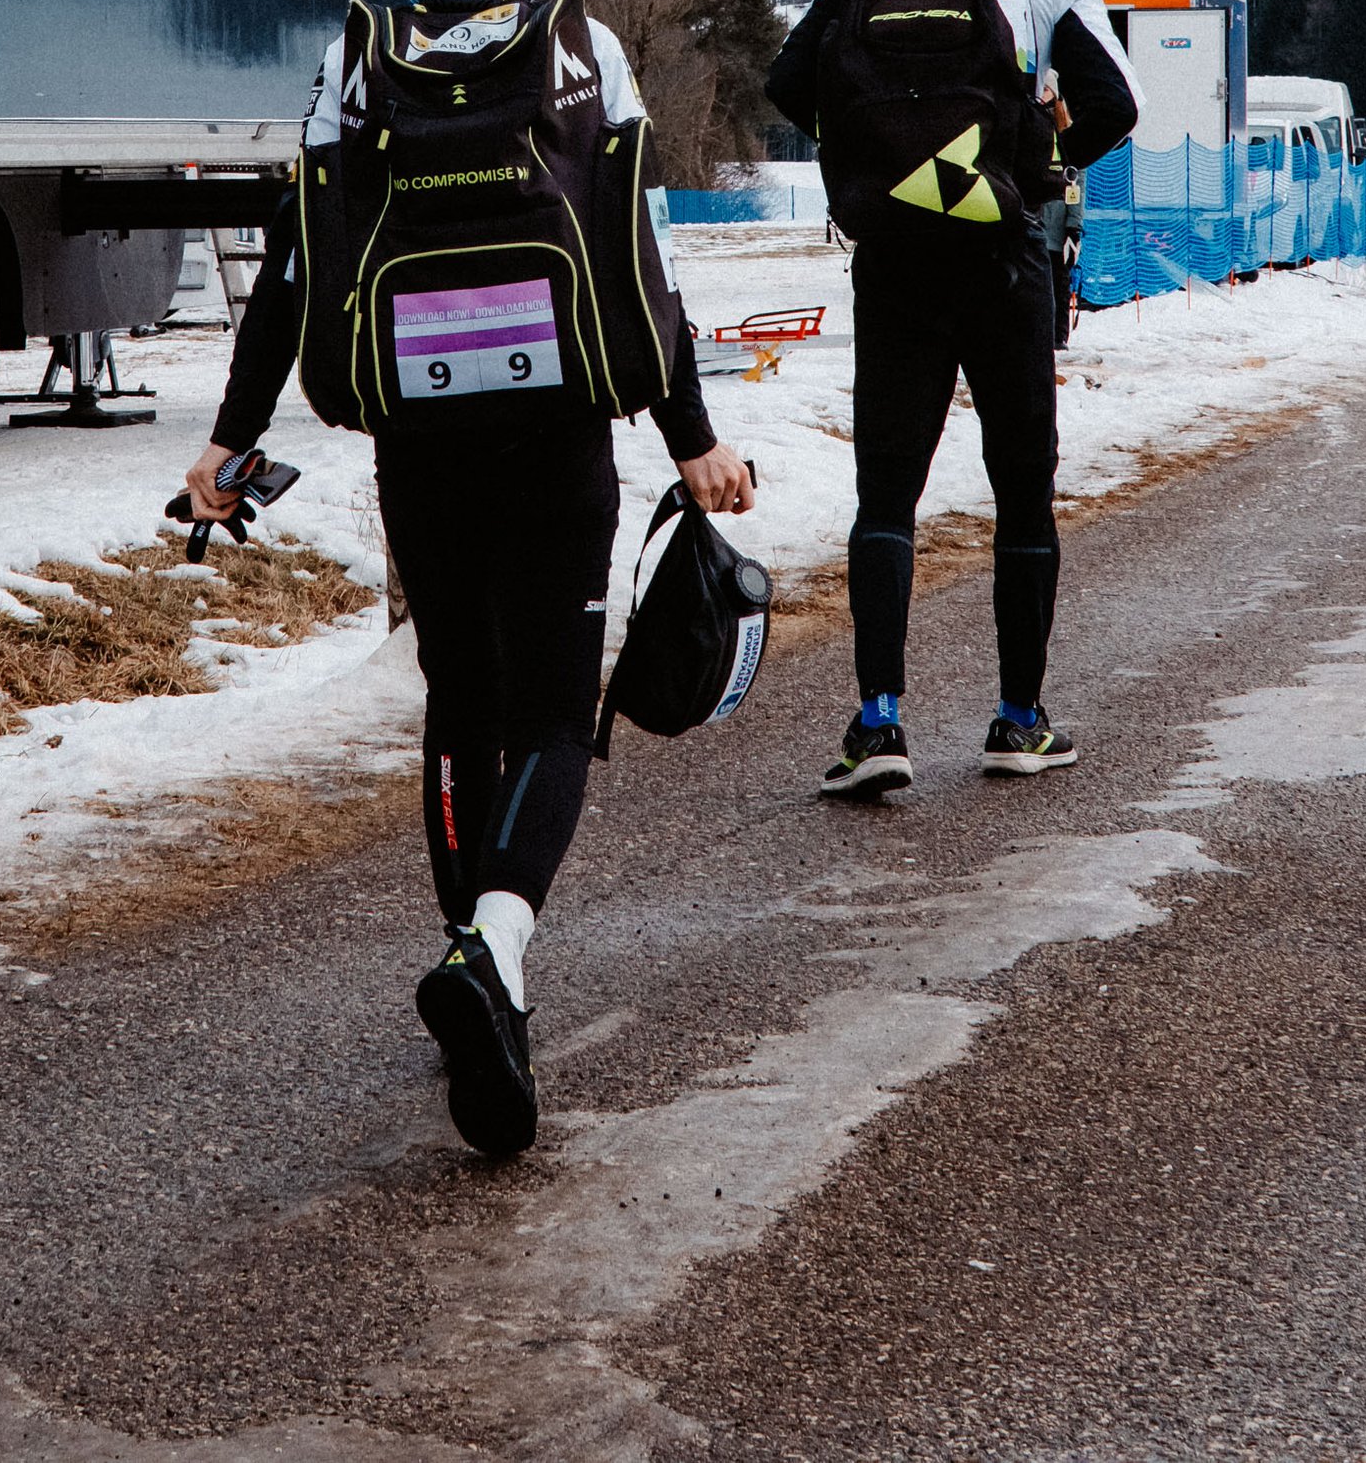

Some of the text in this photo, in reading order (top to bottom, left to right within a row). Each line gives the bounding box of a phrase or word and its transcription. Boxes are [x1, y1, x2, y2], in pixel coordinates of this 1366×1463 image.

[411, 166, 515, 190] COMPROMISE
[397, 311, 445, 325] DOWNLOAD
[475, 301, 525, 318] DOWNLOAD
[427, 351, 533, 391] 9 9
[739, 624, 762, 690] RAKENNUS
[442, 794, 458, 850] TRIAC
